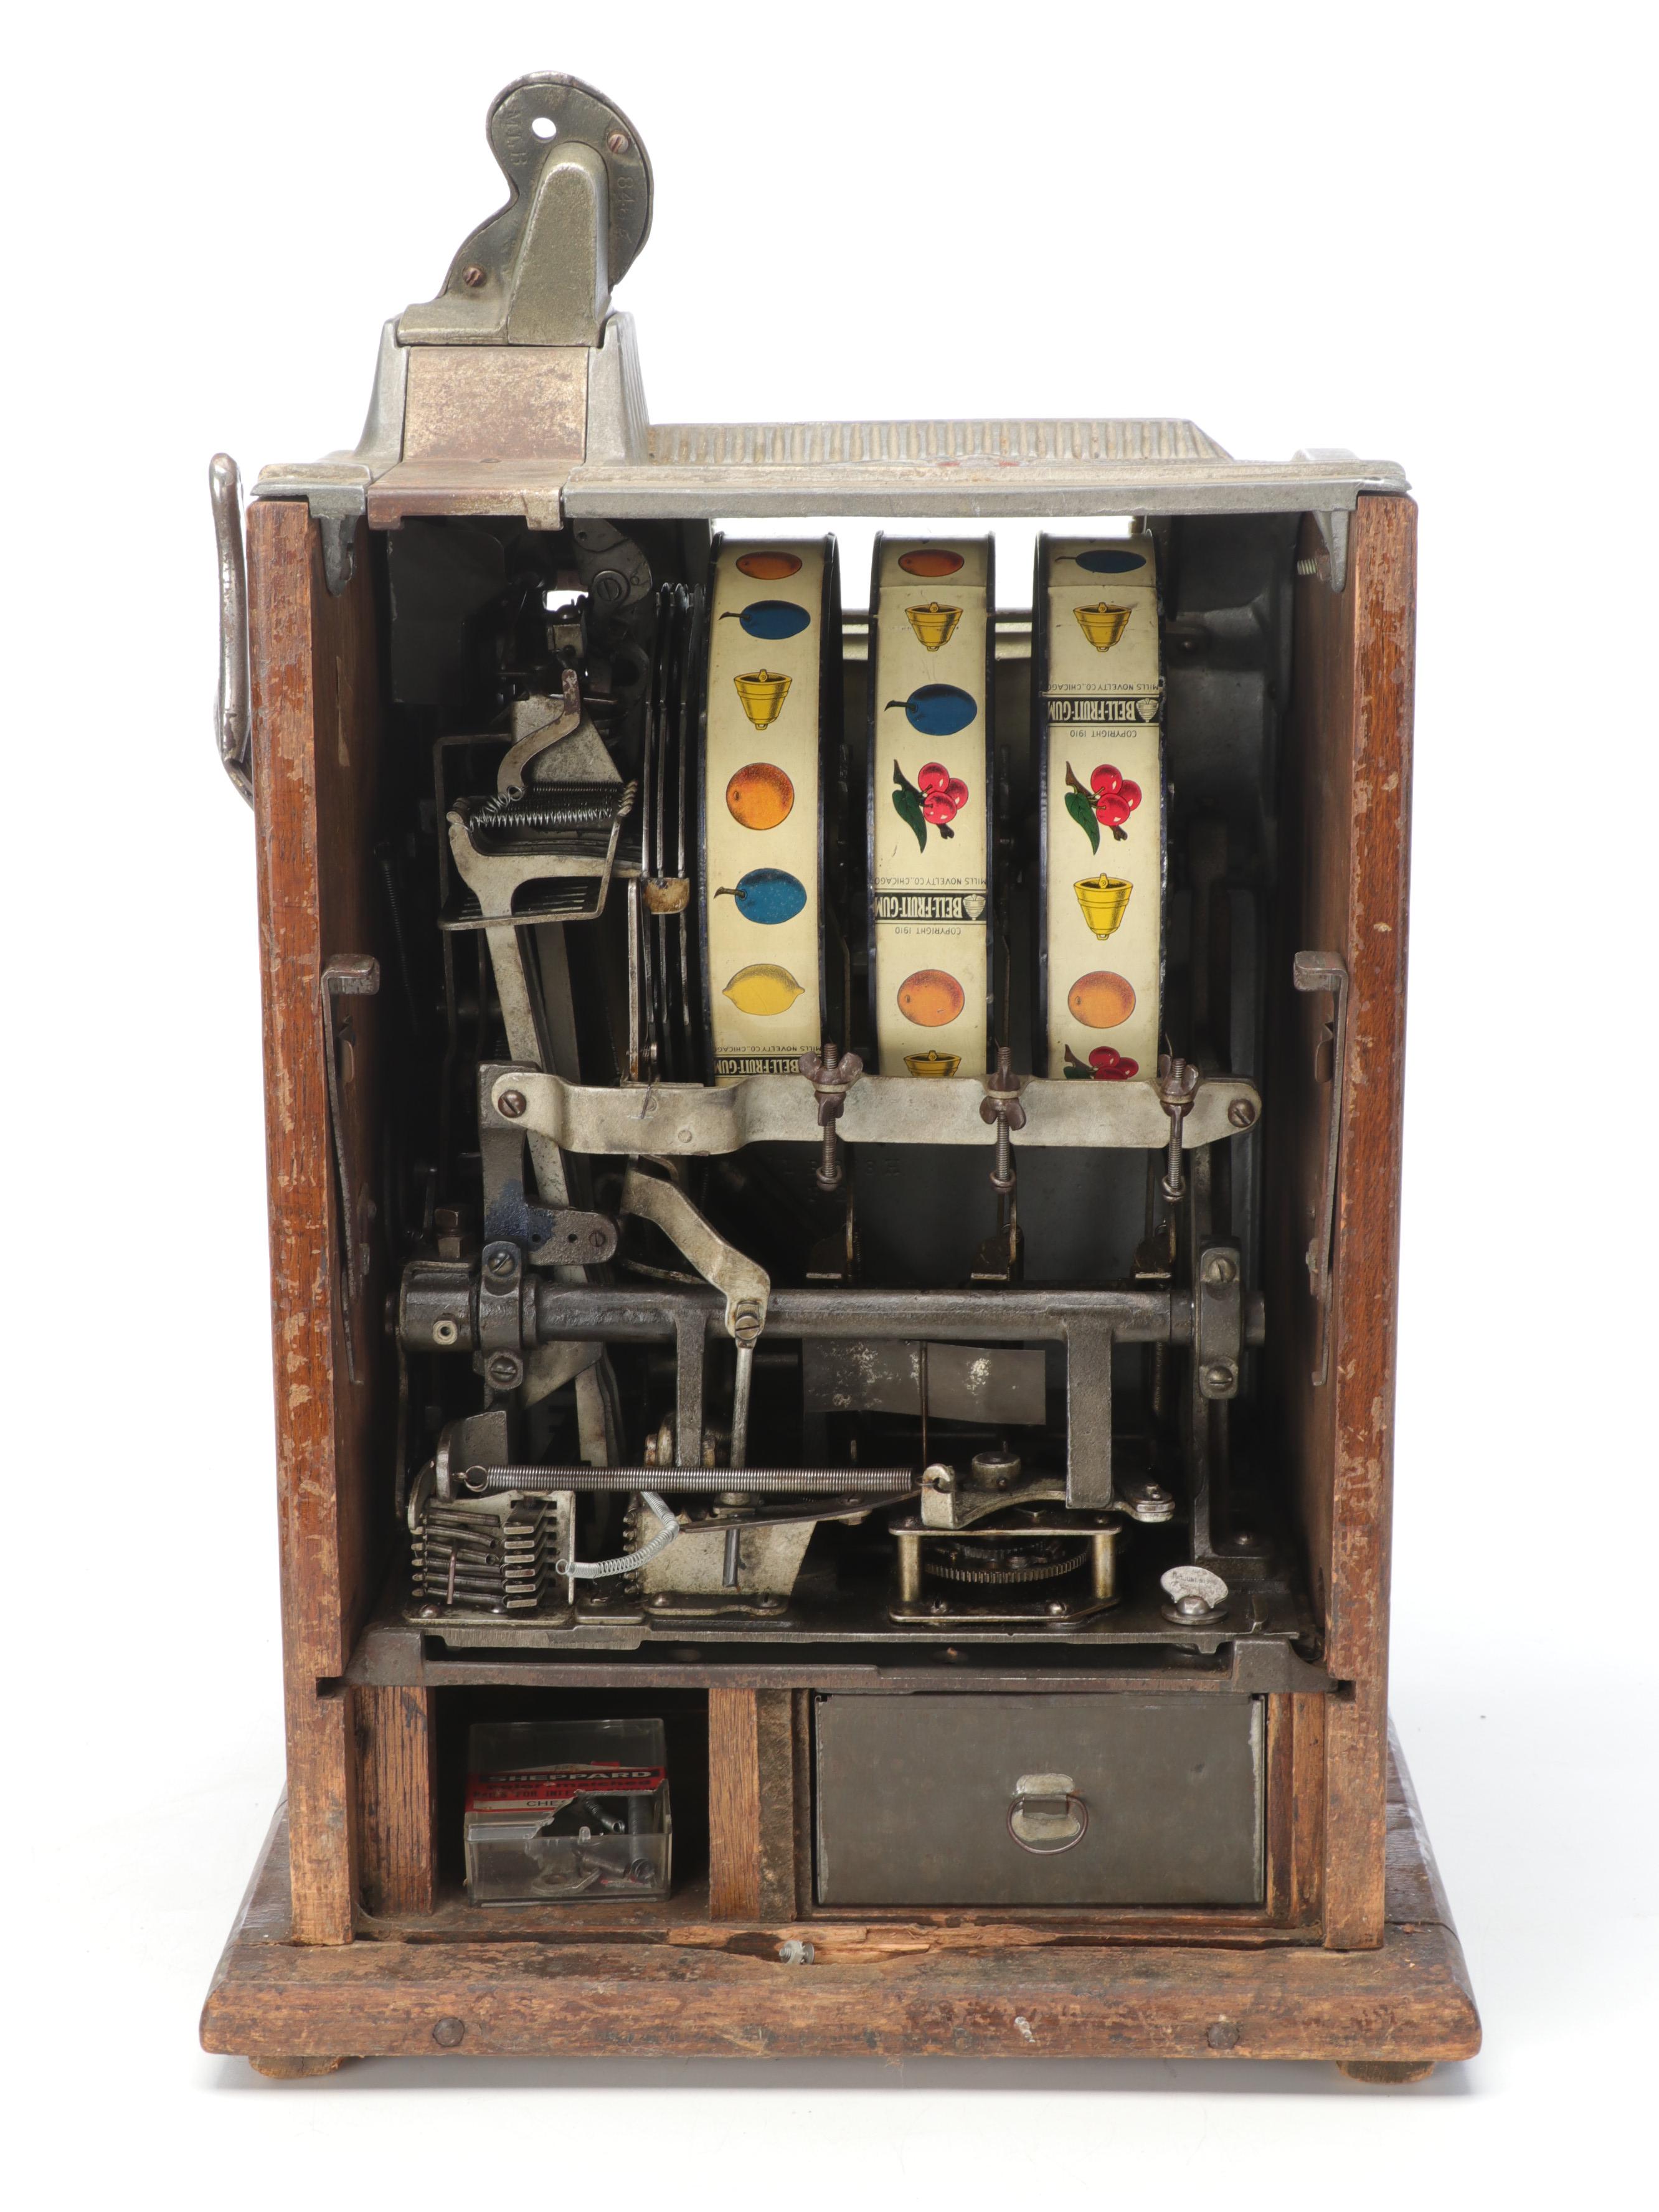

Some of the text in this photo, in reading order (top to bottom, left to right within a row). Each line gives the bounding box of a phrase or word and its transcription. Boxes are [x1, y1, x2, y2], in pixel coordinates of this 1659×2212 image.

[1047, 701, 1136, 721] BELL-FRUIT-GUM
[1070, 730, 1137, 738] COPYRIGHT 1910
[874, 897, 963, 918] BELL-FRUIT-GUM
[895, 927, 962, 935] COPYRIGHT 1910
[488, 1770, 652, 1782] SHEPPARD
